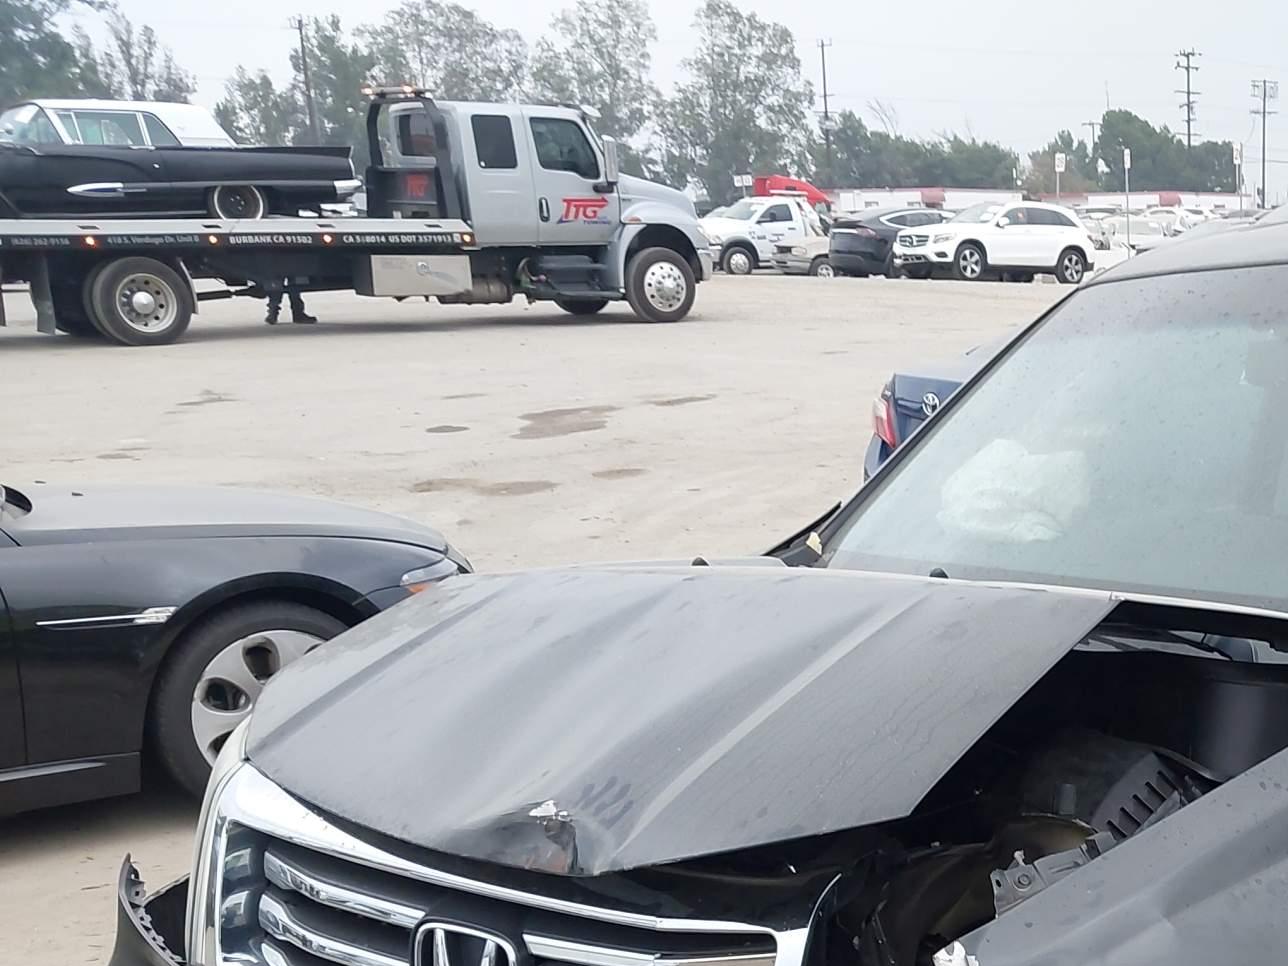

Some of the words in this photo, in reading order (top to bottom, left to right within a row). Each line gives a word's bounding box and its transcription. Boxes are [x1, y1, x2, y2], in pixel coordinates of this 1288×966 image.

[228, 235, 273, 244] BURBANK
[273, 235, 285, 243] CA
[342, 235, 355, 243] CA
[388, 235, 400, 243] US
[400, 235, 416, 243] DOT
